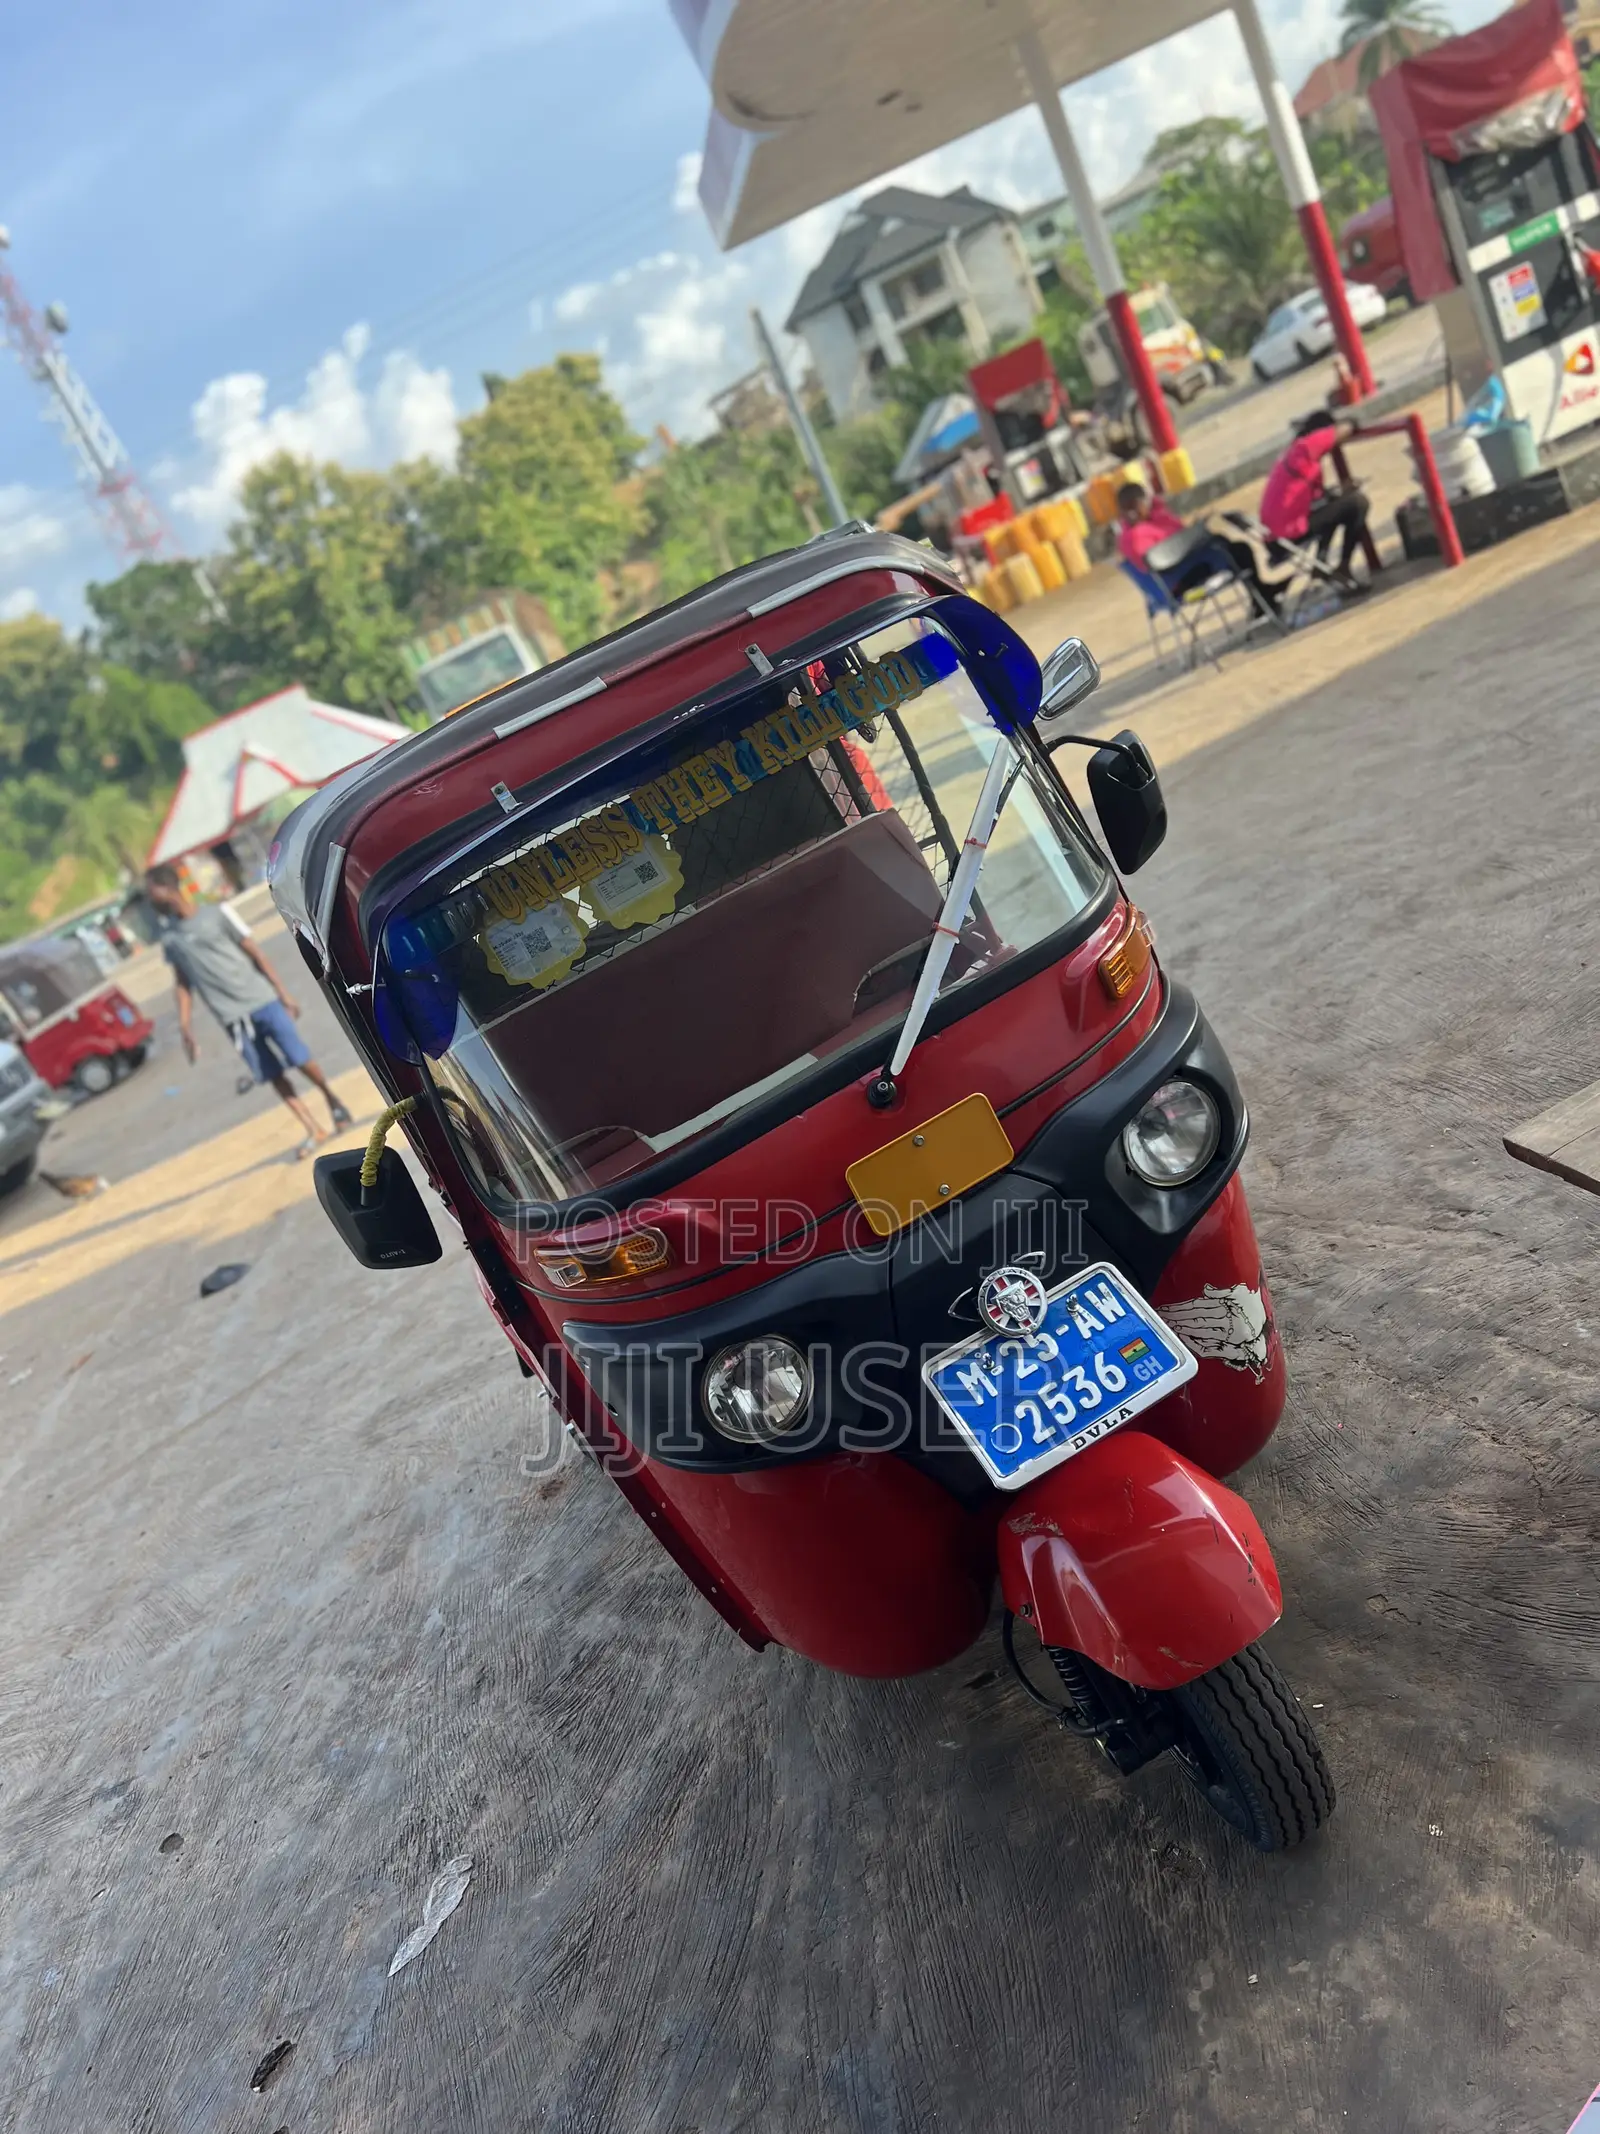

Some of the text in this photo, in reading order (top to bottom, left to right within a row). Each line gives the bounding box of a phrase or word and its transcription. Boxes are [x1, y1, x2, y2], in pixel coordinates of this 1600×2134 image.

[481, 803, 644, 925] UNLESS
[631, 740, 753, 834] THEY
[739, 690, 848, 765] KILL
[834, 651, 923, 722] GOD
[1015, 1352, 1127, 1444] 2536
[1133, 1355, 1163, 1382] GH
[1071, 1407, 1134, 1450] DVLA
